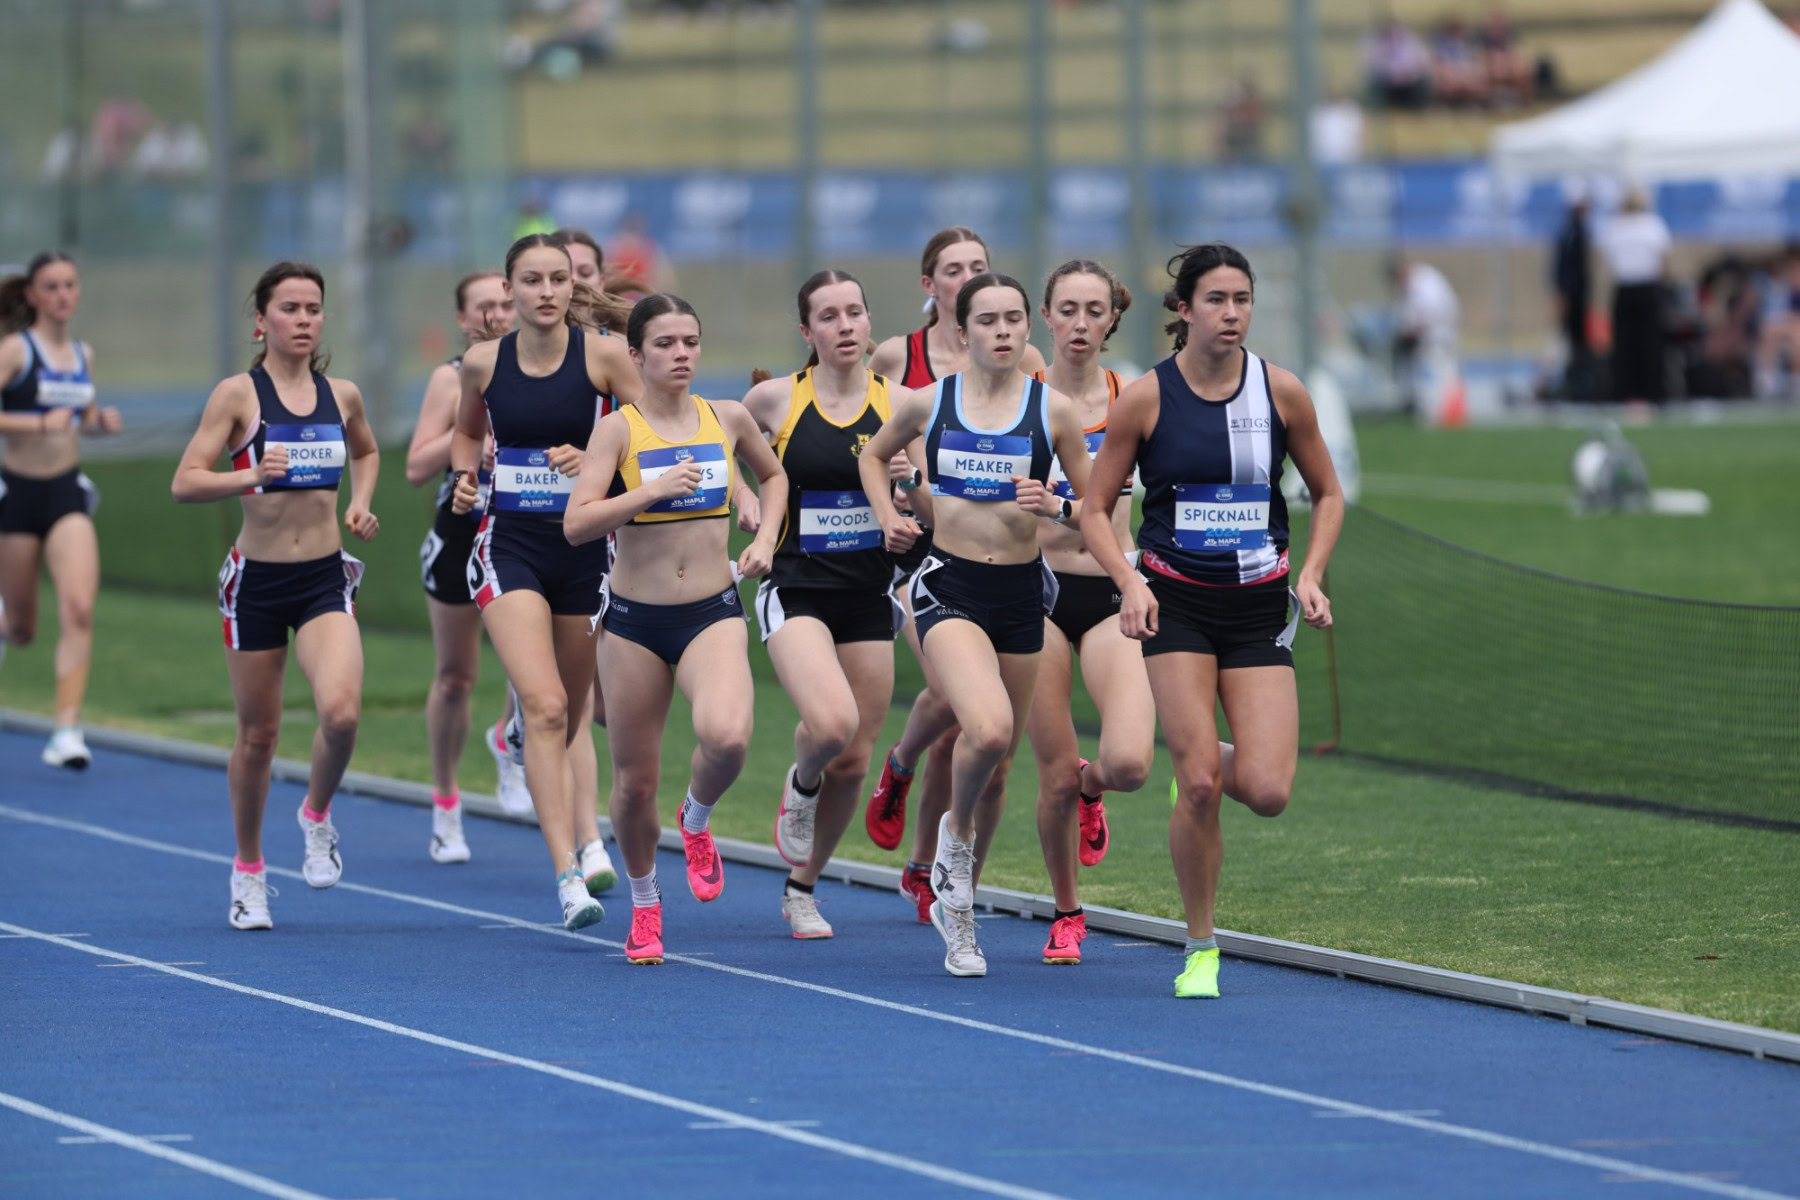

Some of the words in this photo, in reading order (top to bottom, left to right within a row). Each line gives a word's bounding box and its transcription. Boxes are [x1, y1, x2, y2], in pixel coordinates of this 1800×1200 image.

[1240, 418, 1270, 428] TIGS
[955, 458, 1013, 474] MEAKER
[515, 473, 559, 485] BAKER
[965, 476, 1000, 487] 2024
[520, 489, 553, 499] 2024
[684, 496, 706, 504] MAPLE
[817, 512, 870, 526] WOODS
[1184, 508, 1261, 522] SPICKNALL
[828, 530, 859, 540] 2024
[1205, 527, 1240, 537] 2024
